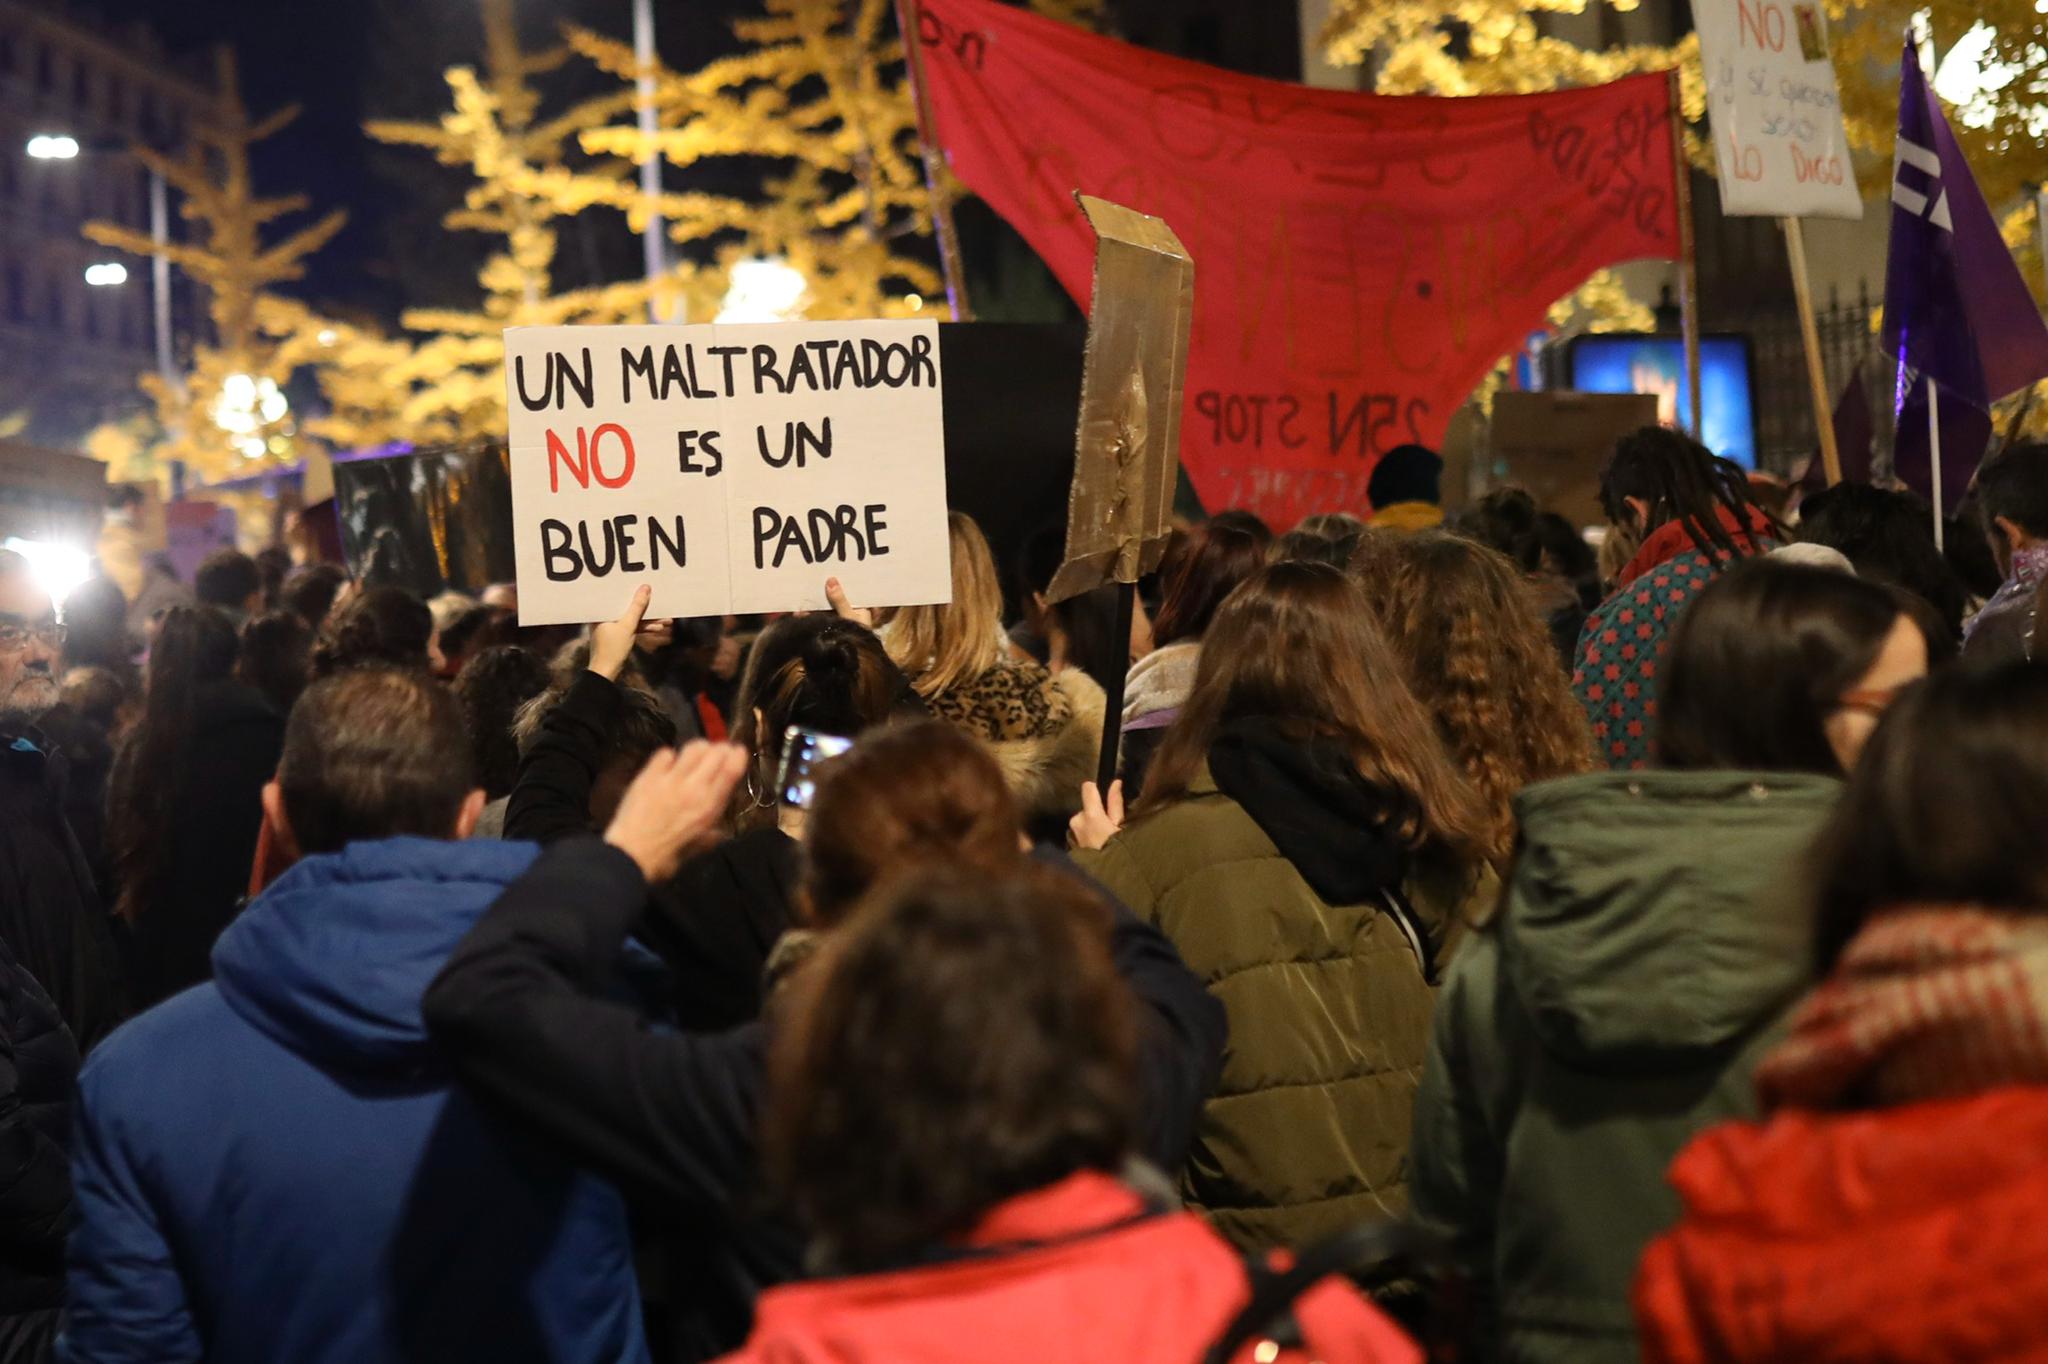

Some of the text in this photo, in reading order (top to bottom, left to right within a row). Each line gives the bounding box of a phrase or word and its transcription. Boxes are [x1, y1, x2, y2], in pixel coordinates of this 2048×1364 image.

[1737, 0, 1786, 53] NO
[1789, 141, 1844, 186] DIGO
[515, 334, 937, 411] UN MALTRATADOR
[545, 416, 833, 494] NO ES UN
[540, 503, 890, 582] BUEN PADRE
